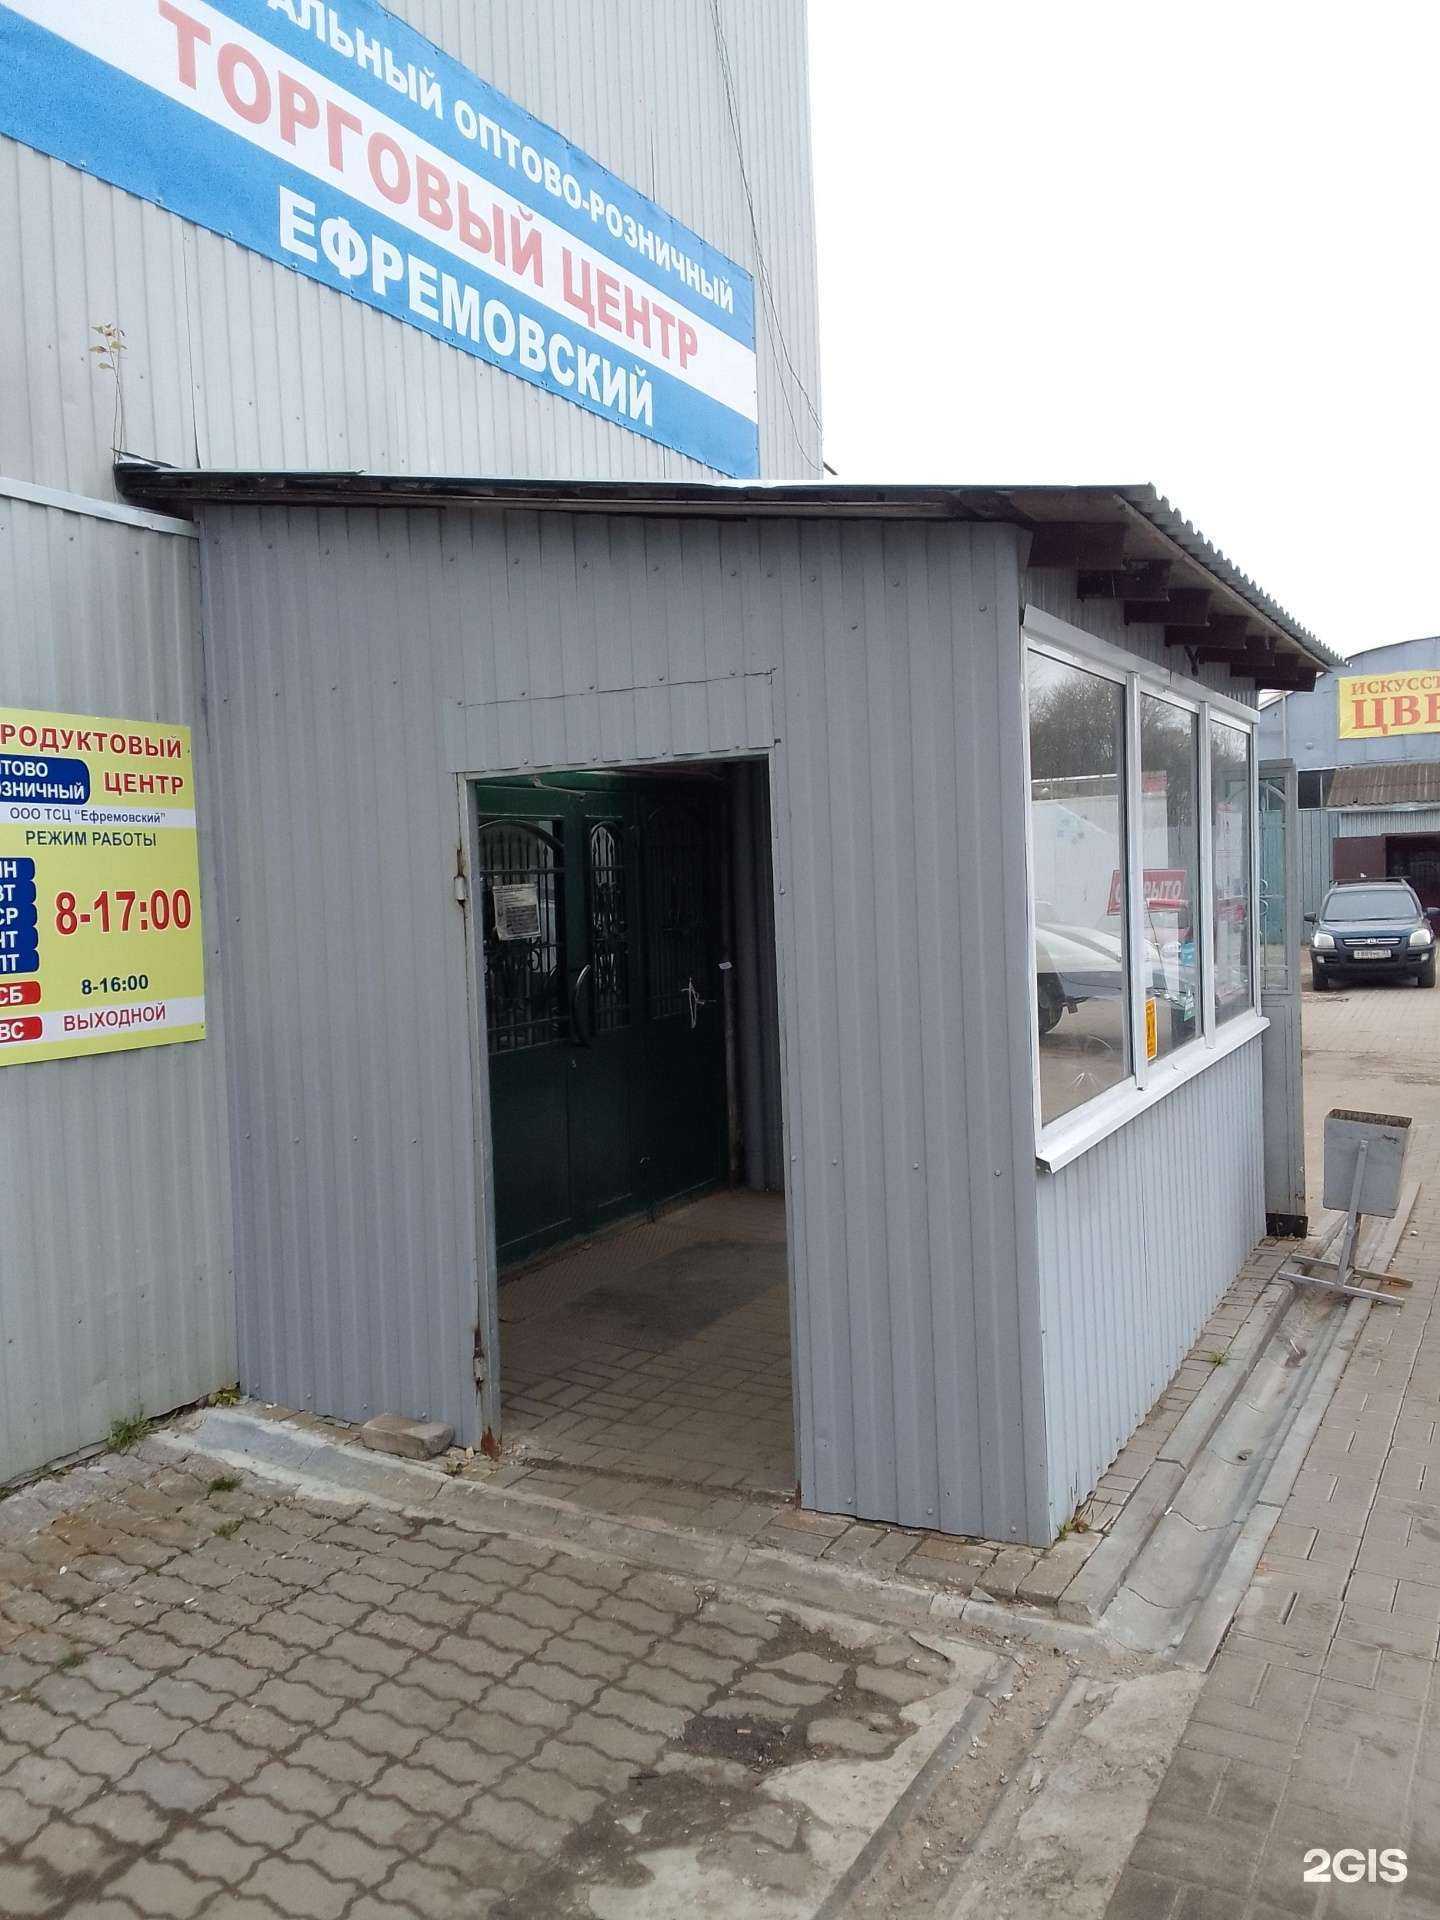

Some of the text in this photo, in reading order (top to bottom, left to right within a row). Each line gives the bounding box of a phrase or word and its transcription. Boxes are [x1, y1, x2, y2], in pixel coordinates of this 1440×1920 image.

[158, 0, 699, 371] ТОРГОВЫЙ ЦЕНТР
[454, 100, 734, 314] ОПТОВО-РОЗНИЧНЫЙ
[279, 186, 654, 428] ЕФРЕМОВСКИЙ
[0, 723, 182, 759] РОДУКТОВЫЙ
[0, 760, 48, 777] ТОВО
[0, 781, 85, 800] ЗНИЧНЫЙ
[104, 772, 184, 796] ЦЕНТР
[10, 807, 41, 820] ООО
[44, 808, 72, 823] ТСЦ
[25, 829, 157, 847] РЕЖИМ РАБОТЫ
[0, 860, 17, 878] Н
[55, 888, 192, 934] 8-17:00
[81, 975, 149, 995] 8-16:00
[64, 1002, 166, 1032] ВЫХОДНОЙ
[0, 1021, 24, 1040] ВС
